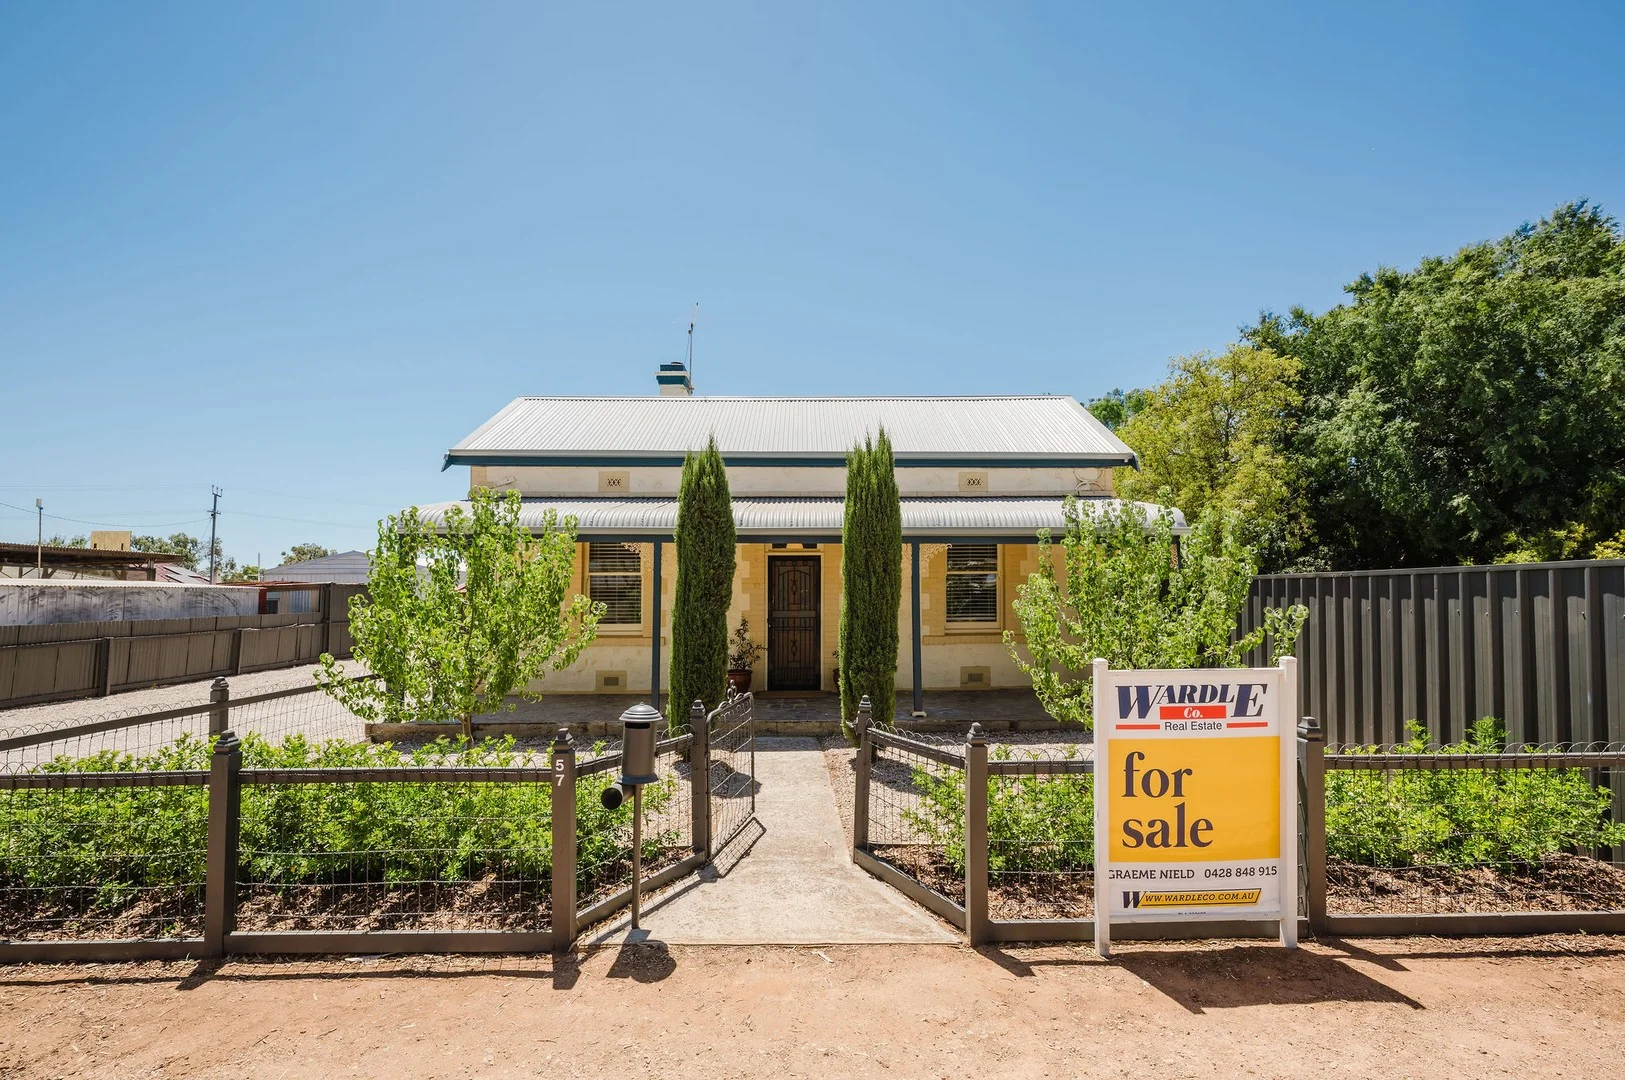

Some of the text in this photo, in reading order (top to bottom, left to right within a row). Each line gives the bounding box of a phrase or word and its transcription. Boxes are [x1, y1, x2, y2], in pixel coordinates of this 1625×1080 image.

[1115, 684, 1268, 719] WARDLE
[1183, 707, 1204, 719] Co.
[1164, 721, 1222, 731] Real Estate
[1121, 751, 1193, 798] for
[1122, 801, 1214, 848] sale
[1159, 869, 1195, 879] NIELD
[1204, 868, 1232, 879] 0428
[1235, 867, 1256, 877] 848
[1258, 865, 1278, 876] 915
